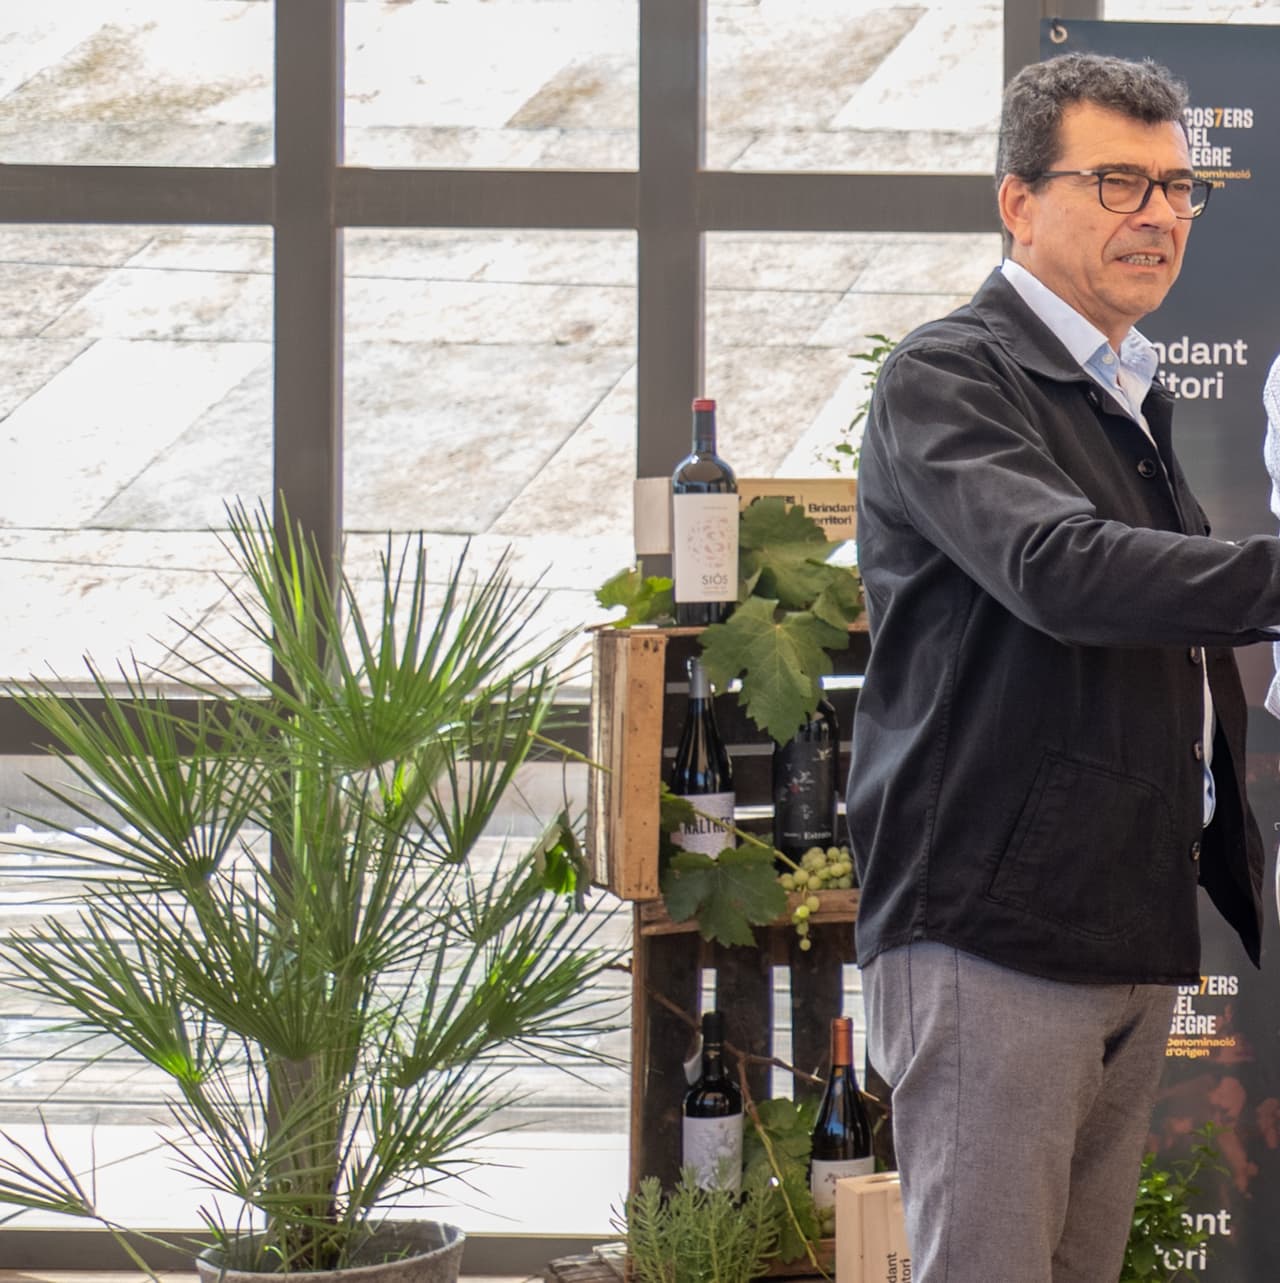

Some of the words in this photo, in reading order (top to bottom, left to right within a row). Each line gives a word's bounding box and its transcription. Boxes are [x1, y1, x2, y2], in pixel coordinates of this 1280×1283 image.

[1191, 147, 1232, 167] EGRE
[1193, 169, 1251, 179] nominació
[1151, 336, 1249, 366] ndant
[809, 503, 857, 513] Brindan
[1173, 996, 1196, 1015] EL
